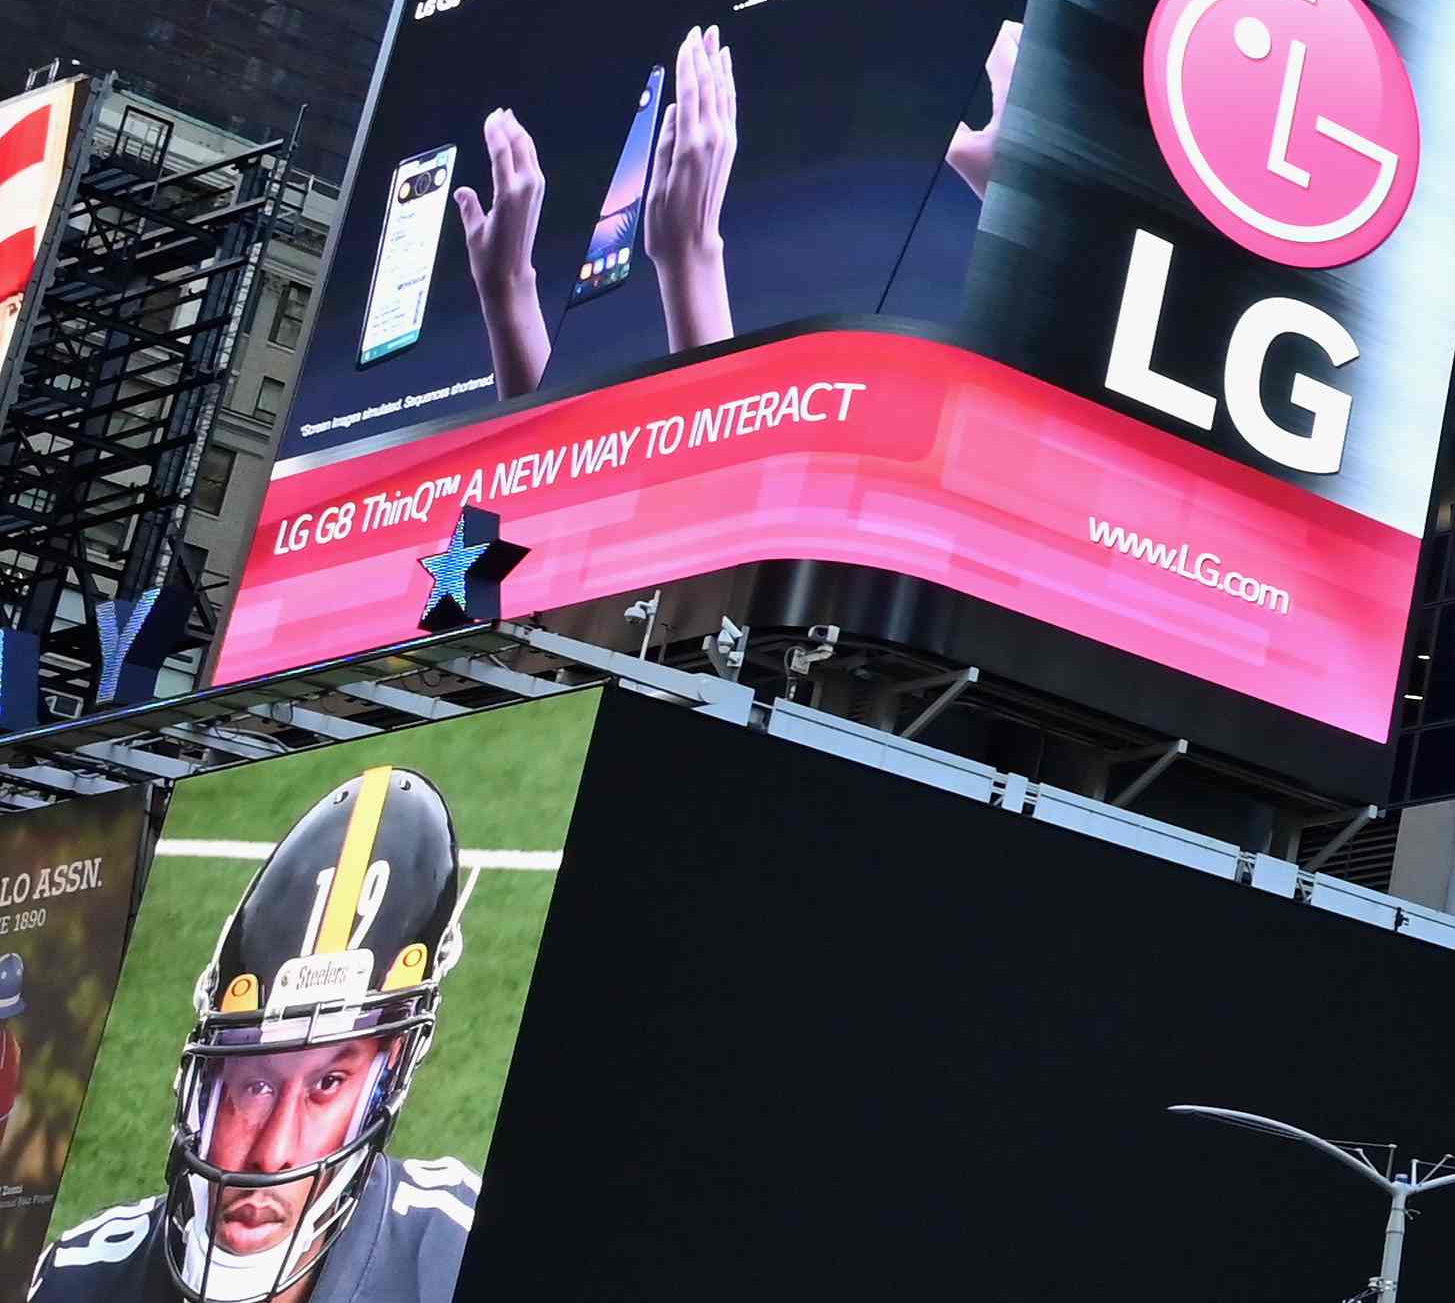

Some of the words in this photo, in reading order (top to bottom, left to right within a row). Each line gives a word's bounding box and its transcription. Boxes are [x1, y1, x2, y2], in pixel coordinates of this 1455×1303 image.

[1104, 228, 1359, 474] LG
[274, 514, 312, 555] LG
[315, 501, 356, 544] G8
[460, 469, 482, 507] A
[489, 446, 568, 499] NEW
[570, 425, 640, 479] WAY
[645, 415, 684, 458] TO
[688, 382, 867, 448] INTERACT
[1088, 515, 1291, 615] www.LG.com
[13, 907, 47, 932] 1890
[32, 857, 102, 899] ASSN.
